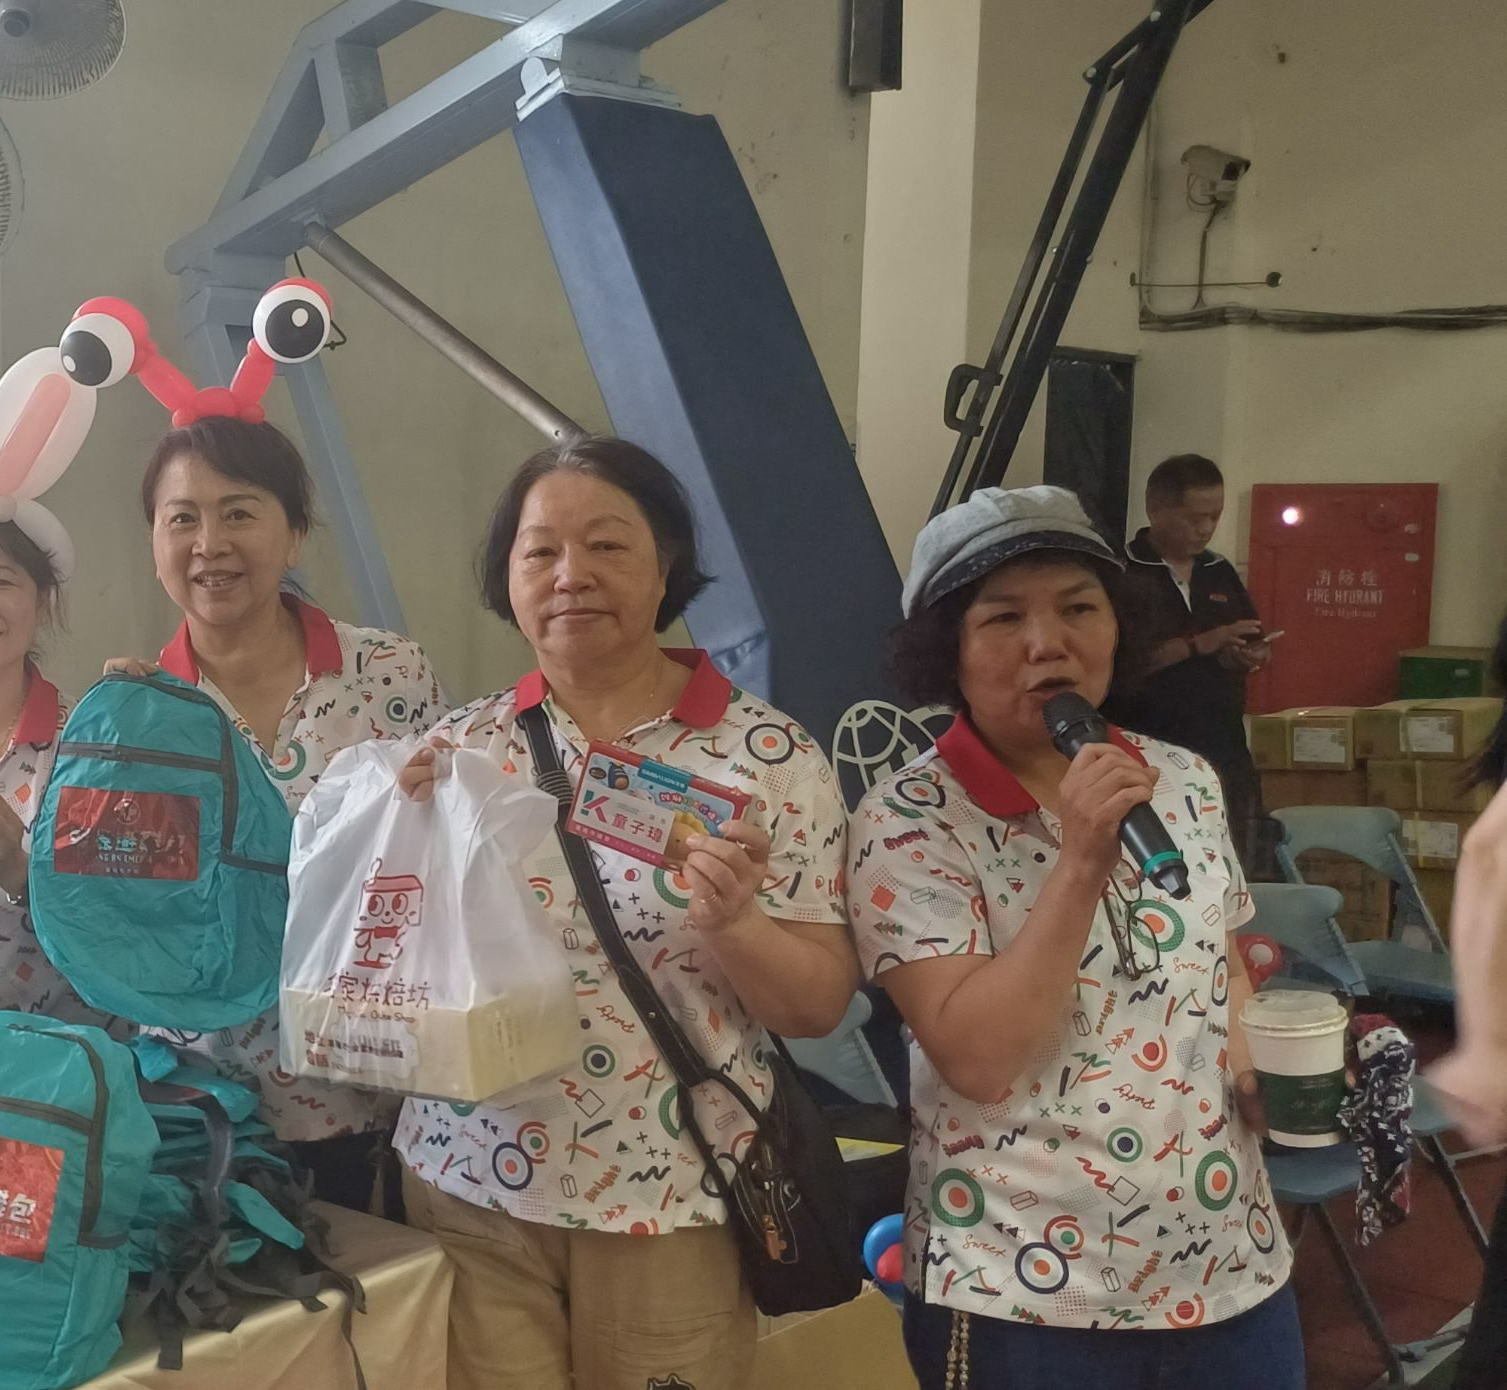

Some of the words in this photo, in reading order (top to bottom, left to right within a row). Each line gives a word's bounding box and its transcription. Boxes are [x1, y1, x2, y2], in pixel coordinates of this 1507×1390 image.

[1306, 588, 1330, 604] FIRE
[1334, 590, 1384, 605] HYDRANT
[324, 972, 431, 1010] 家烘焙坊
